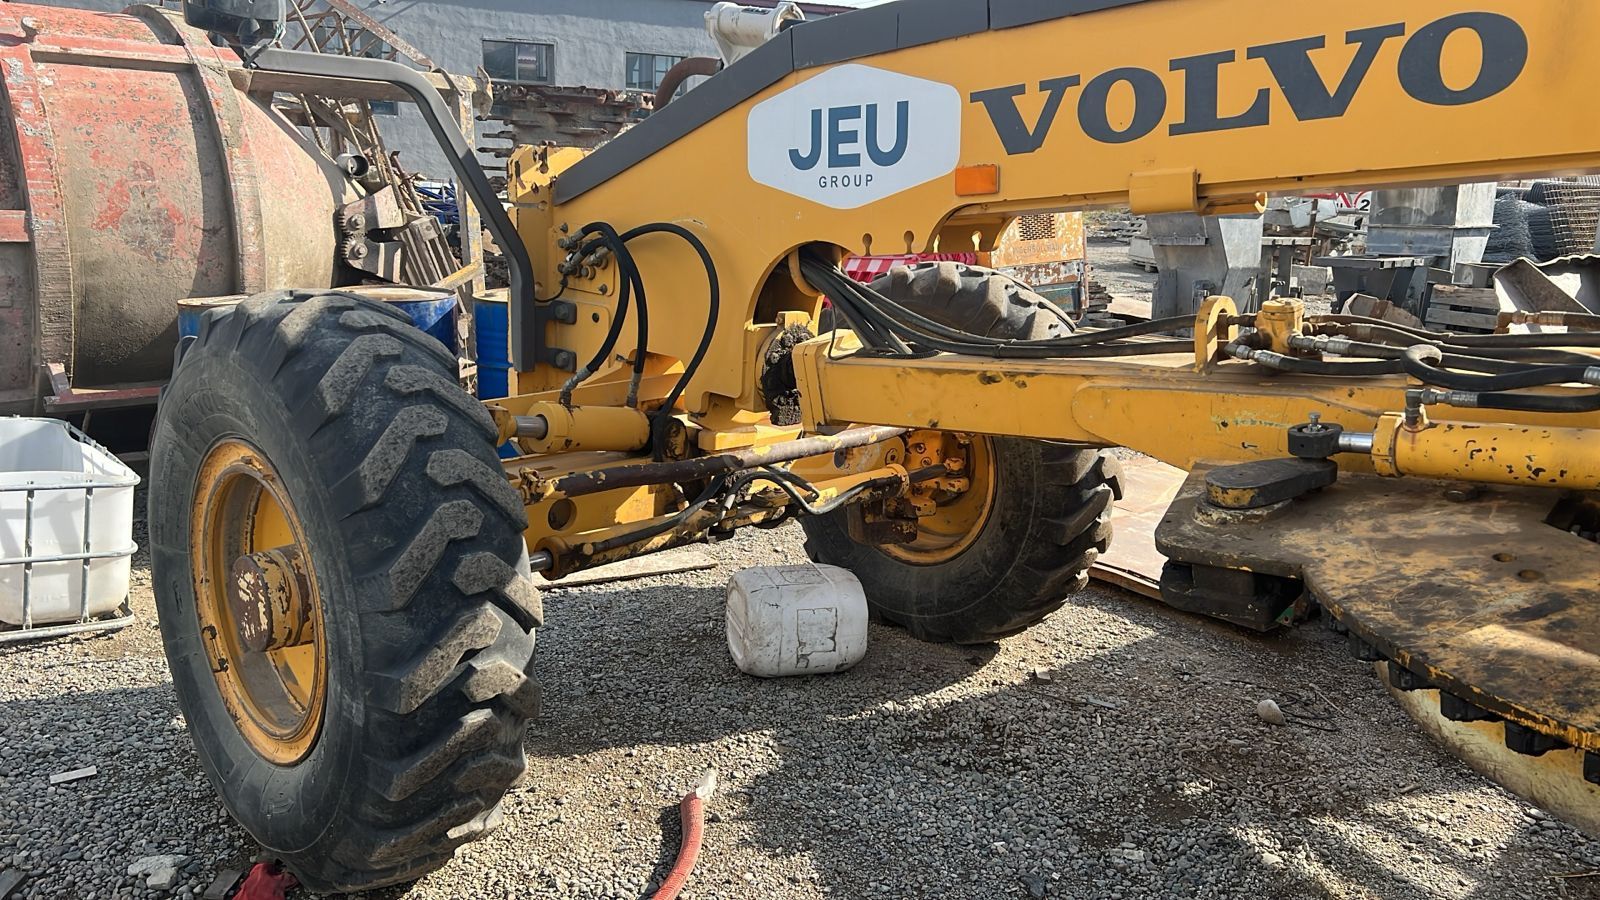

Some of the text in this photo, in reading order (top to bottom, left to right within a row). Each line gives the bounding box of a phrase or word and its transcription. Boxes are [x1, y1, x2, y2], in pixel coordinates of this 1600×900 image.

[970, 12, 1529, 156] VOLVO
[789, 101, 909, 171] JEU
[818, 174, 873, 189] GROUP
